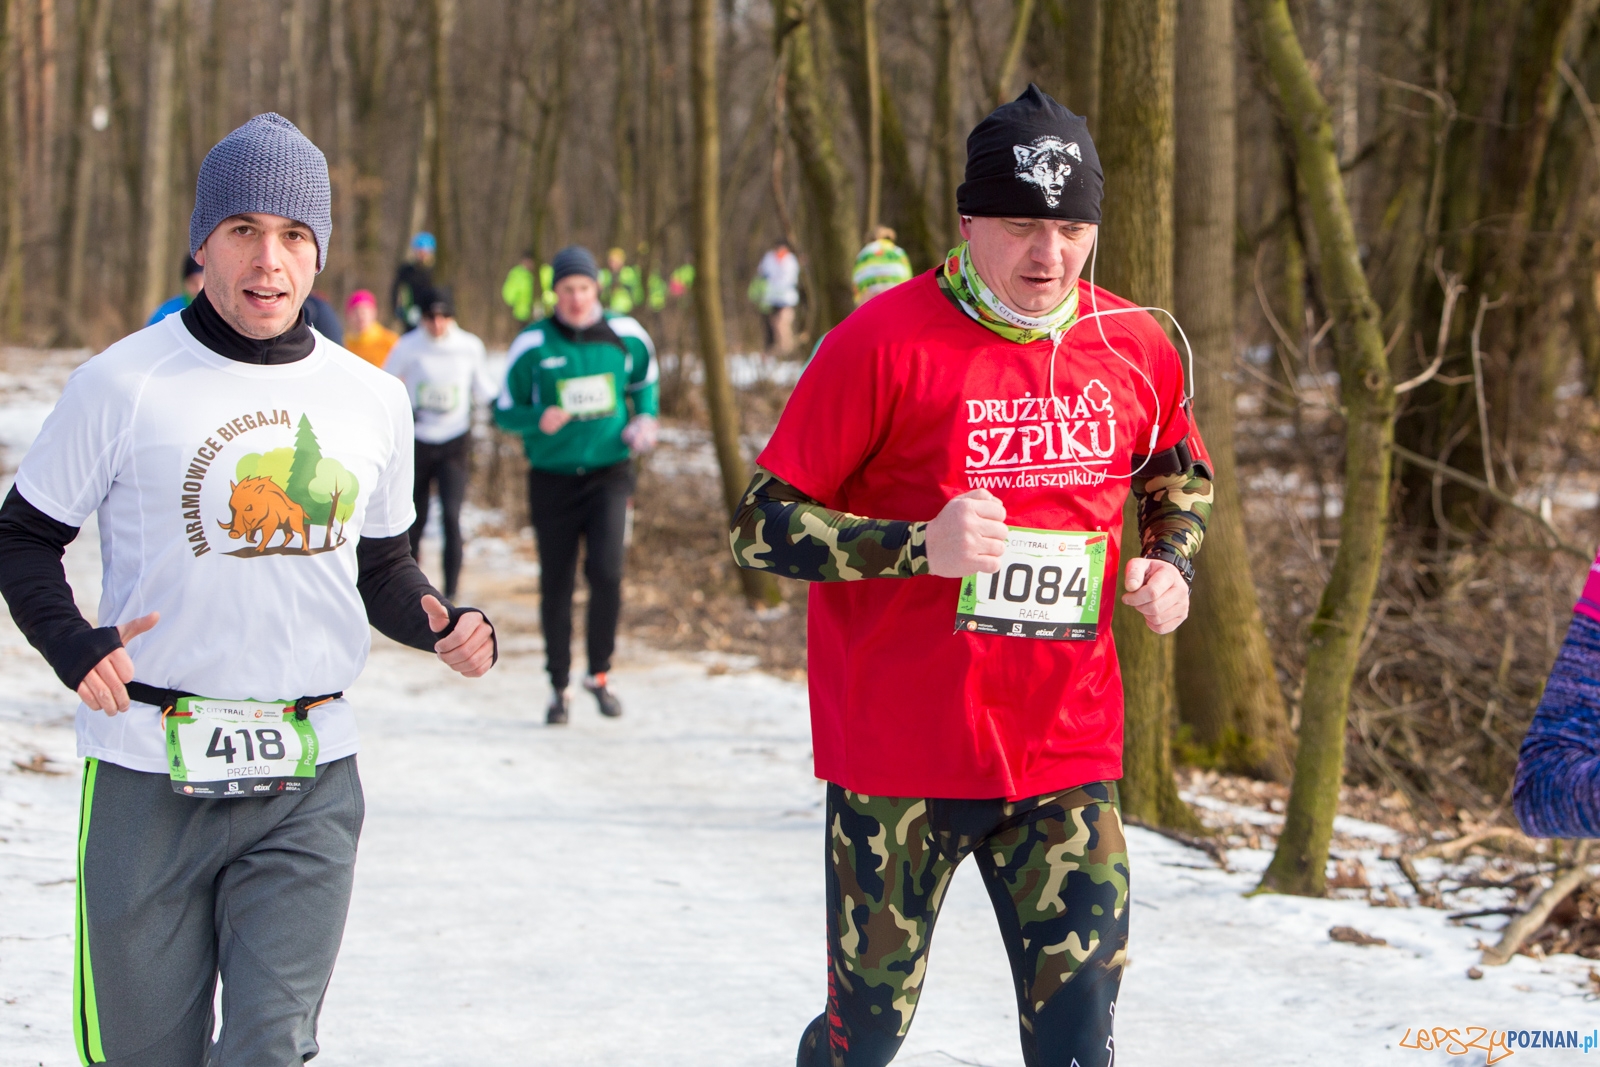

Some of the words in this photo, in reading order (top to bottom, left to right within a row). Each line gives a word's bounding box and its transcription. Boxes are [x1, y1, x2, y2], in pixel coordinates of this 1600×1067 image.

[966, 391, 1091, 424] DRUŻYNA
[966, 419, 1117, 467] SZPIKU
[181, 437, 224, 557] NARAMOWICE
[216, 409, 292, 442] BIEGAJĄ
[967, 469, 1107, 490] www.darszpiku.pl
[988, 563, 1087, 606] 1084
[1088, 576, 1099, 612] Poznań
[1019, 609, 1050, 620] RAFAŁ
[205, 727, 285, 764] 418
[303, 734, 312, 766] Poznań
[227, 765, 270, 778] PRZEMO
